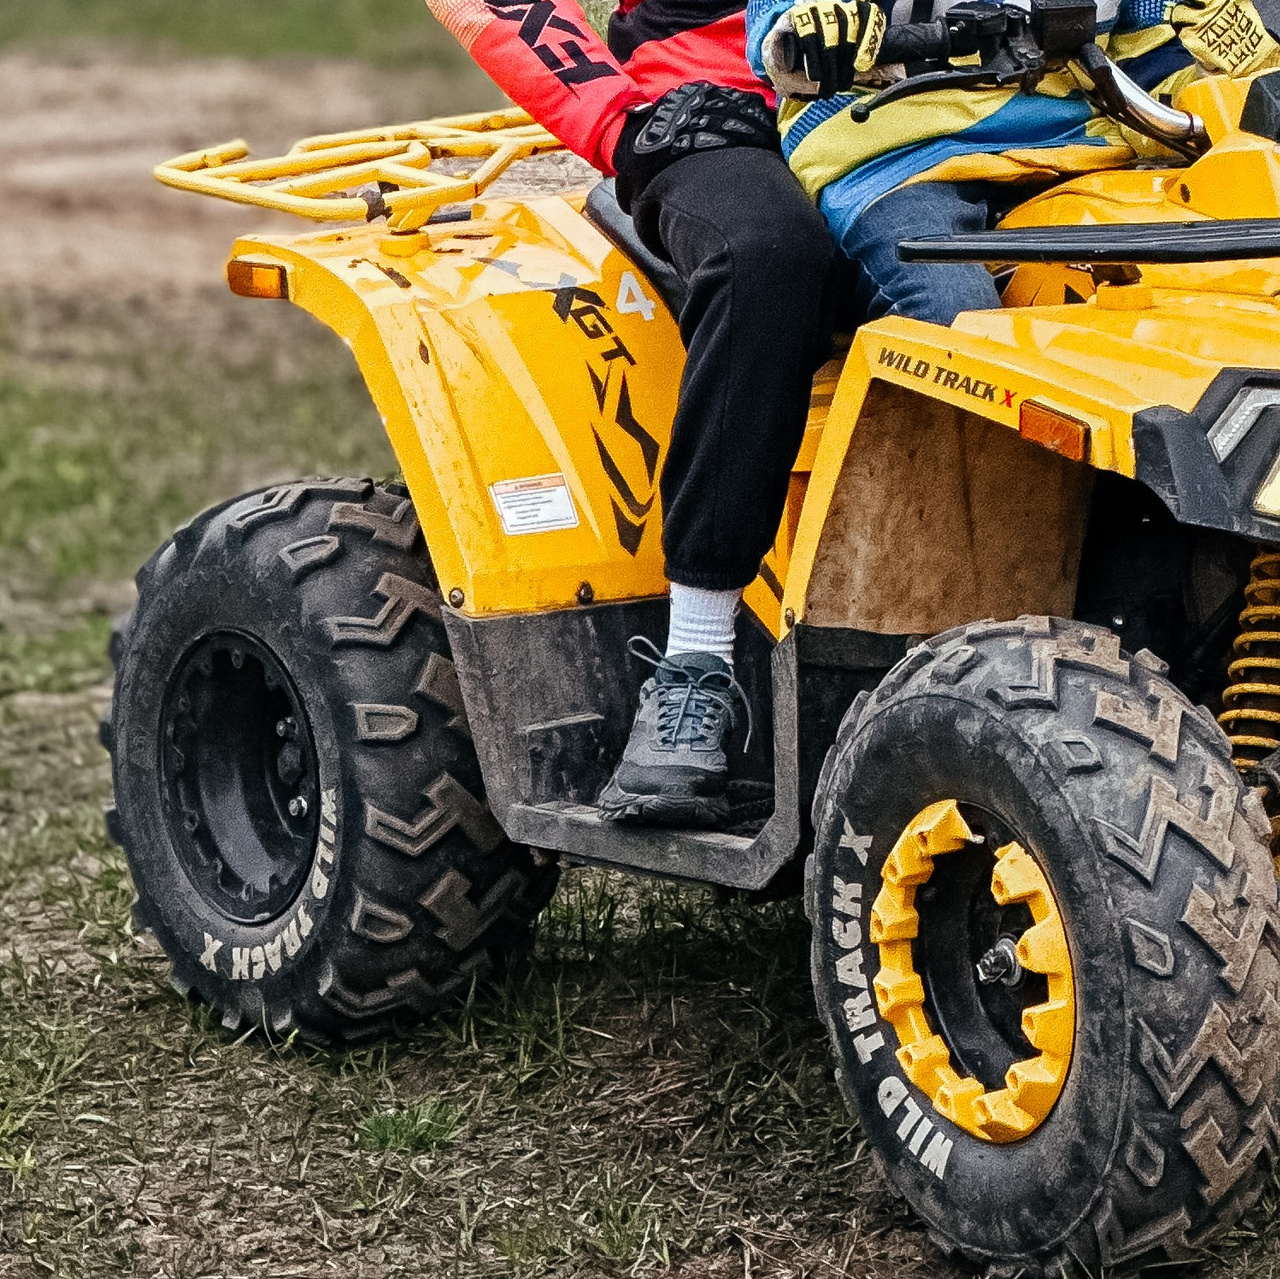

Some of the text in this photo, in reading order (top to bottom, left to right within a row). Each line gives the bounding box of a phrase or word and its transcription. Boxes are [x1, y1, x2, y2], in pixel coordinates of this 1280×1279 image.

[616, 271, 656, 322] 4
[878, 346, 1018, 408] WILD TRACK X
[199, 788, 338, 980] WILD TRACK X
[831, 805, 954, 1181] WILD TRACK X
